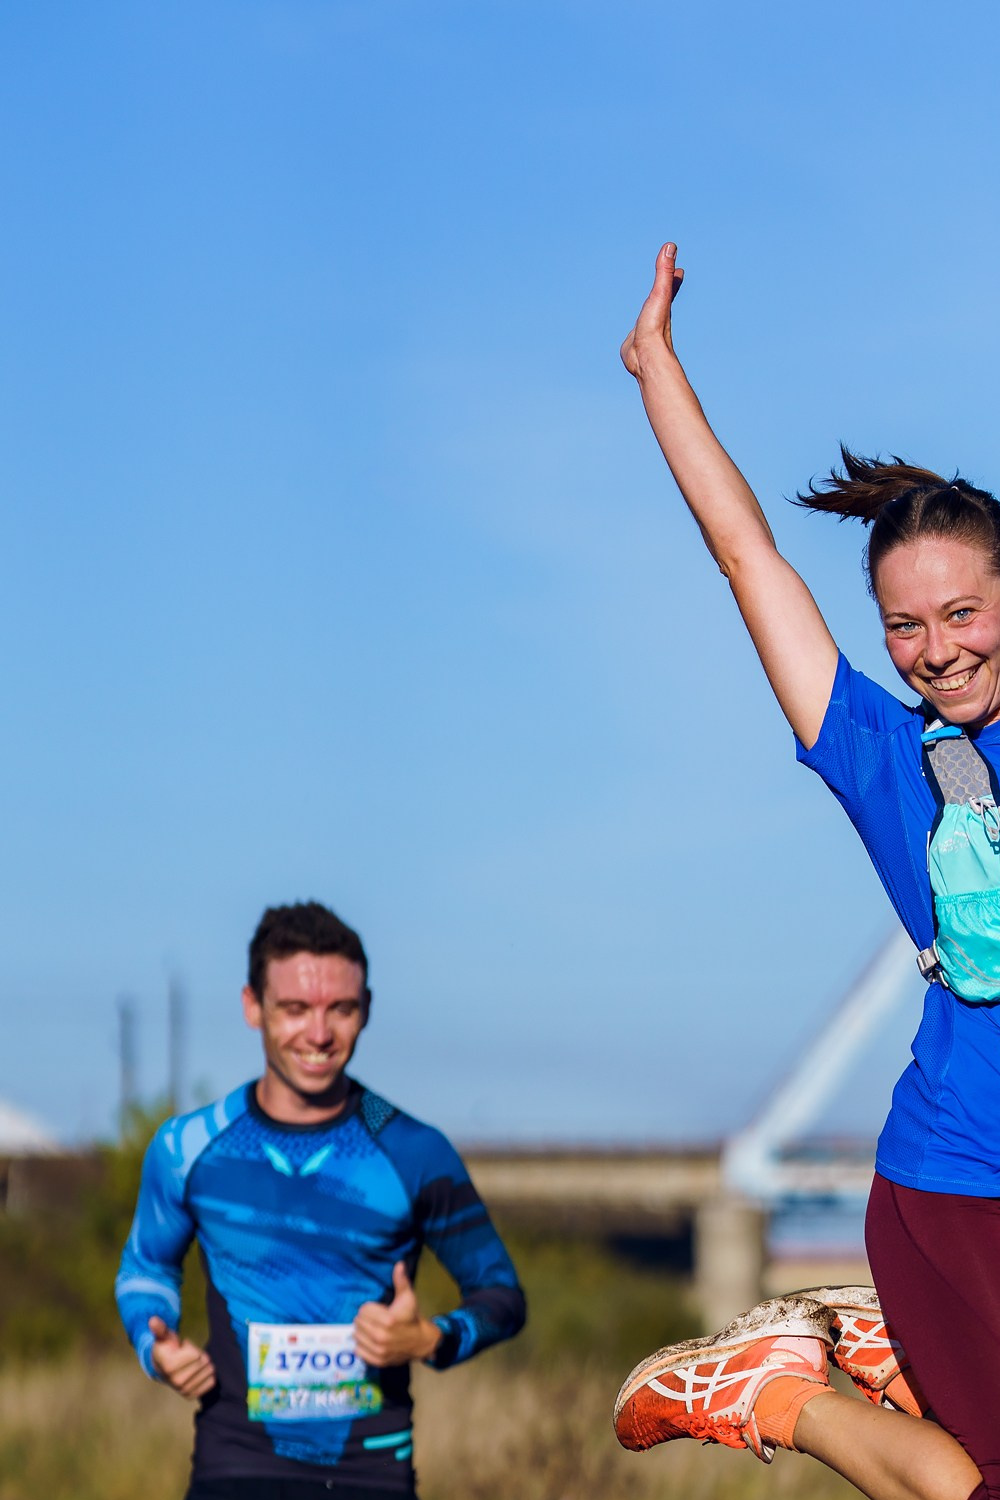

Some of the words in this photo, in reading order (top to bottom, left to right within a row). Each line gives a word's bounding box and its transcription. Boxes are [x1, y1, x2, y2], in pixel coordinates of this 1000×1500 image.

[277, 1350, 356, 1371] 1700
[288, 1388, 309, 1409] 17
[314, 1390, 348, 1407] КМ
